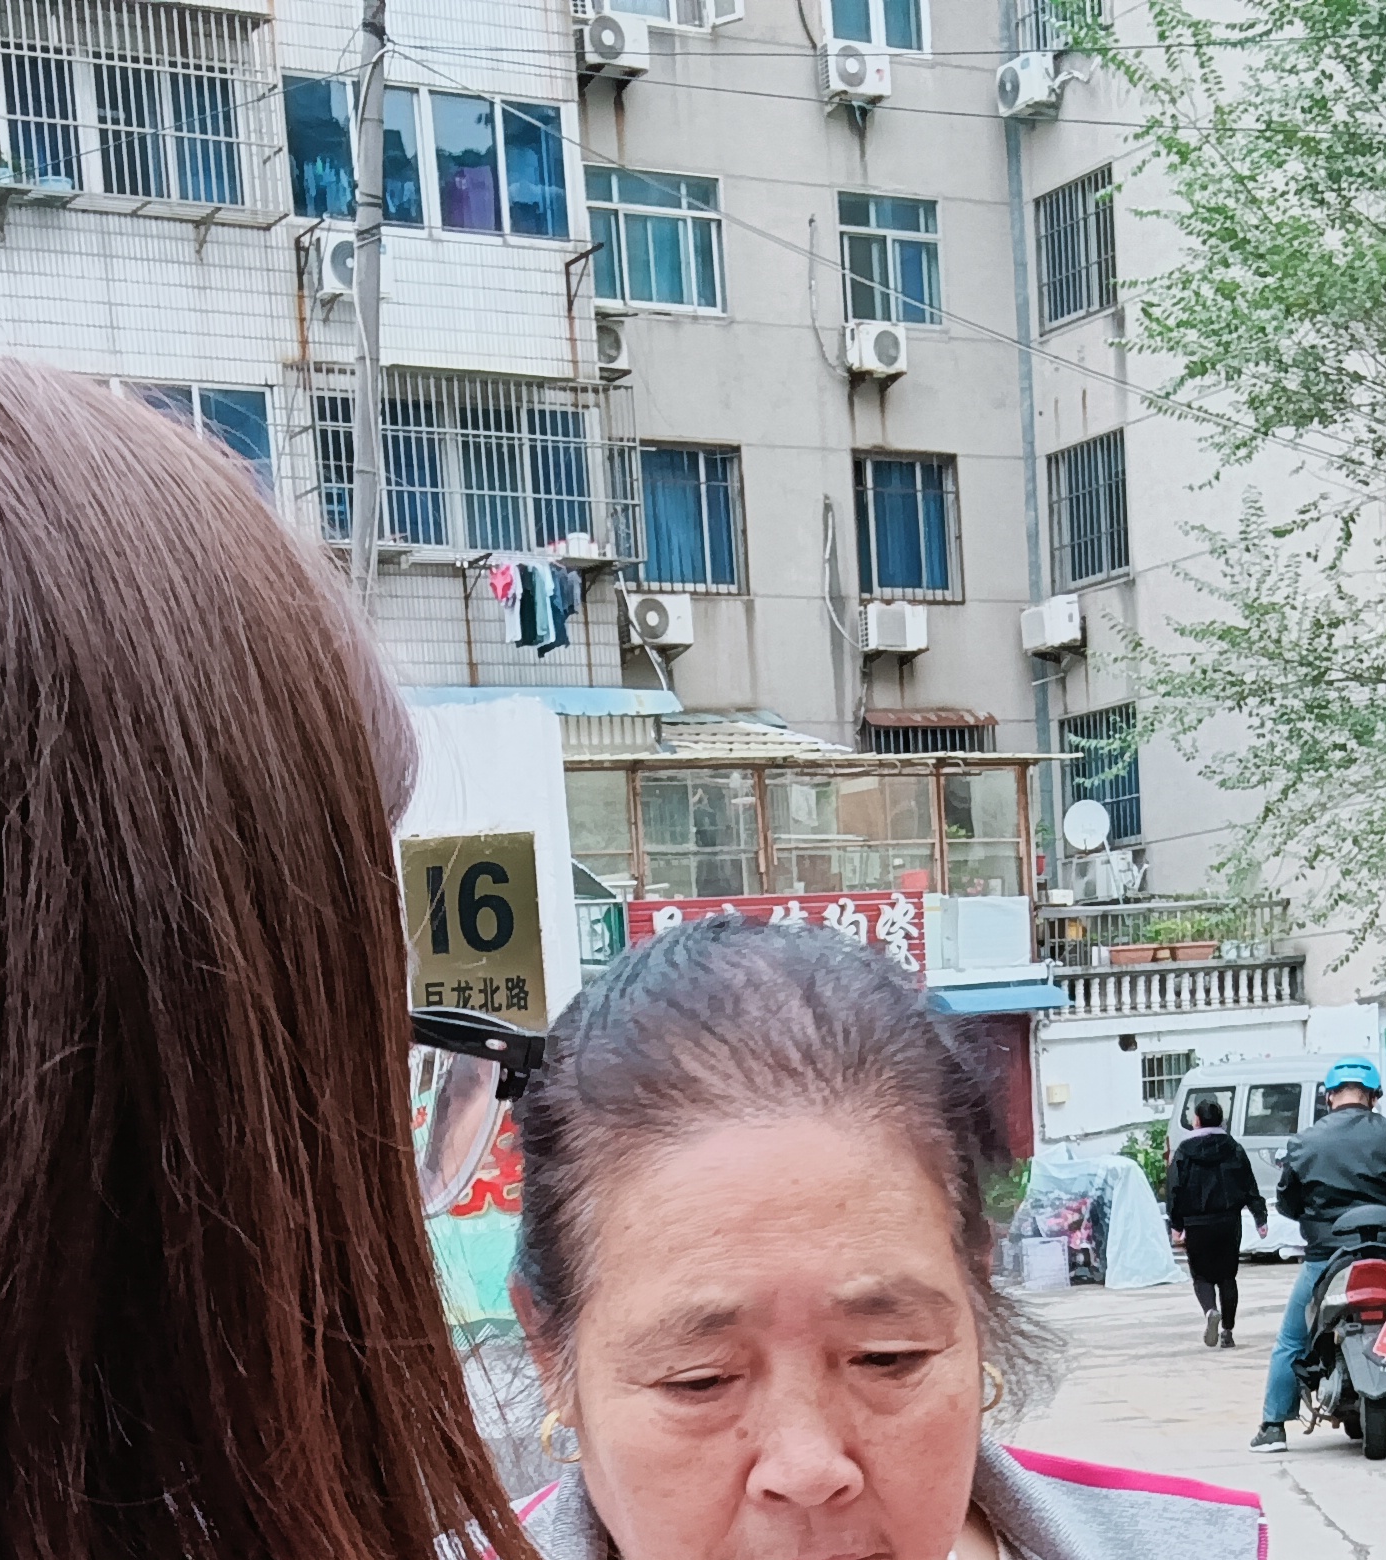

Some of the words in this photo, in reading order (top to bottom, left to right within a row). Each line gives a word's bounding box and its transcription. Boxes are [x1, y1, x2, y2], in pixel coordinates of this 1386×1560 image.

[426, 861, 514, 954] 16
[424, 975, 529, 1012] 巨龙北路
